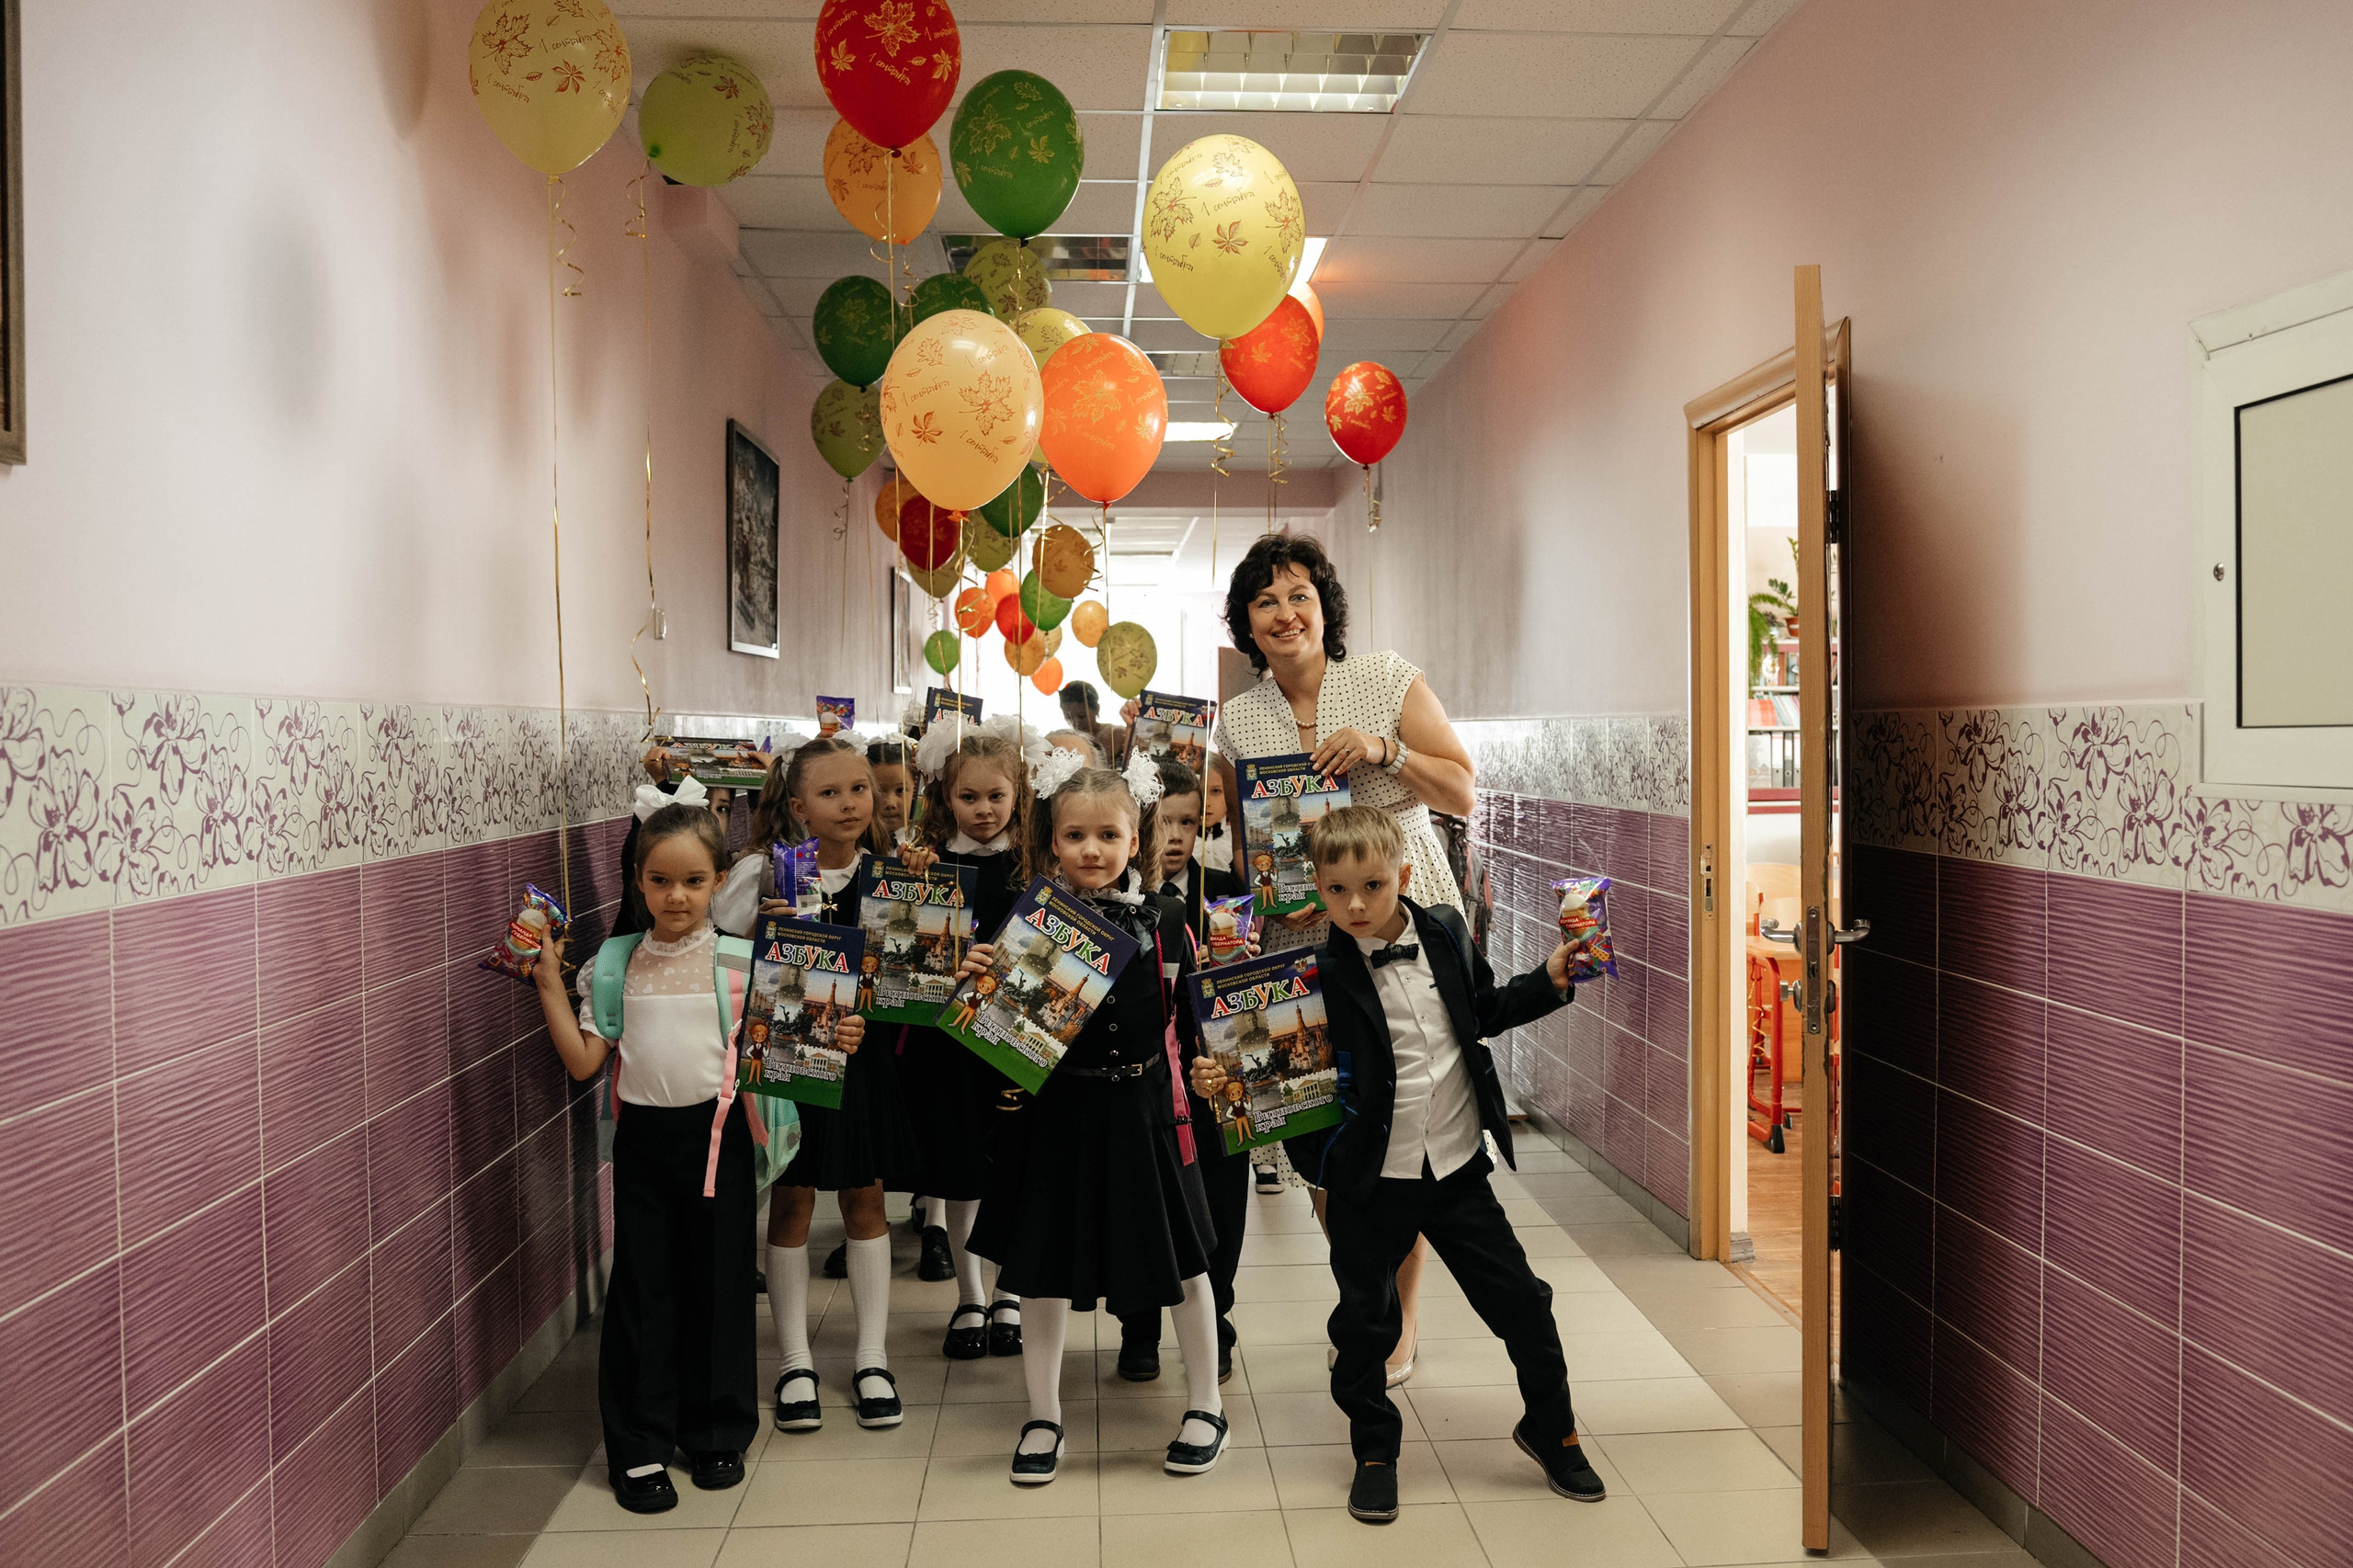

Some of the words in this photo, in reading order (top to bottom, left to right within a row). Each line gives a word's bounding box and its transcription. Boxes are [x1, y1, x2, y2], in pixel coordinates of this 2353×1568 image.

[551, 29, 594, 50] сентября
[876, 60, 911, 85] сентября
[493, 80, 530, 103] сентября
[1213, 187, 1256, 211] сентября
[1159, 255, 1194, 272] сентября
[977, 341, 1011, 364] сентября
[910, 377, 950, 403] сентября
[966, 437, 999, 464] сентября
[1143, 706, 1204, 727] АЗБУКА
[1252, 774, 1339, 799] АЗБУКА
[872, 880, 964, 907] АЗБУКА
[1278, 892, 1306, 903] края
[1049, 901, 1077, 922] МОСКОВСКОЙ
[1076, 920, 1097, 936] ОБЛАСТИ
[1051, 896, 1077, 915] ЛЕНИНСКИЙ
[1076, 913, 1101, 932] ГОРОДСКОЙ
[1100, 930, 1115, 941] ОКРУГ
[777, 932, 805, 940] МОСКОВСКОЙ
[778, 926, 802, 936] ЛЕНИНСКИЙ
[802, 930, 828, 938] ГОРОДСКОЙ
[1025, 907, 1110, 976] АЗБУКА
[765, 941, 849, 973] АЗБУКА
[1216, 974, 1244, 985] ЛЕНИНСКИЙ
[1244, 967, 1271, 978] ГОРОДСКОЙ
[1217, 978, 1248, 989] МОСКОВСКОЙ
[1248, 972, 1270, 982] ОБЛАСТИ
[876, 996, 905, 1008] края
[878, 985, 949, 1004] Видновског
[1211, 976, 1310, 1018] АЗБУКА
[971, 1021, 1001, 1045] края
[978, 1011, 1047, 1067] Видновского
[764, 1069, 791, 1083] края
[766, 1057, 837, 1081] Видновского
[1253, 1094, 1333, 1123] Видновского
[1255, 1116, 1286, 1133] края
